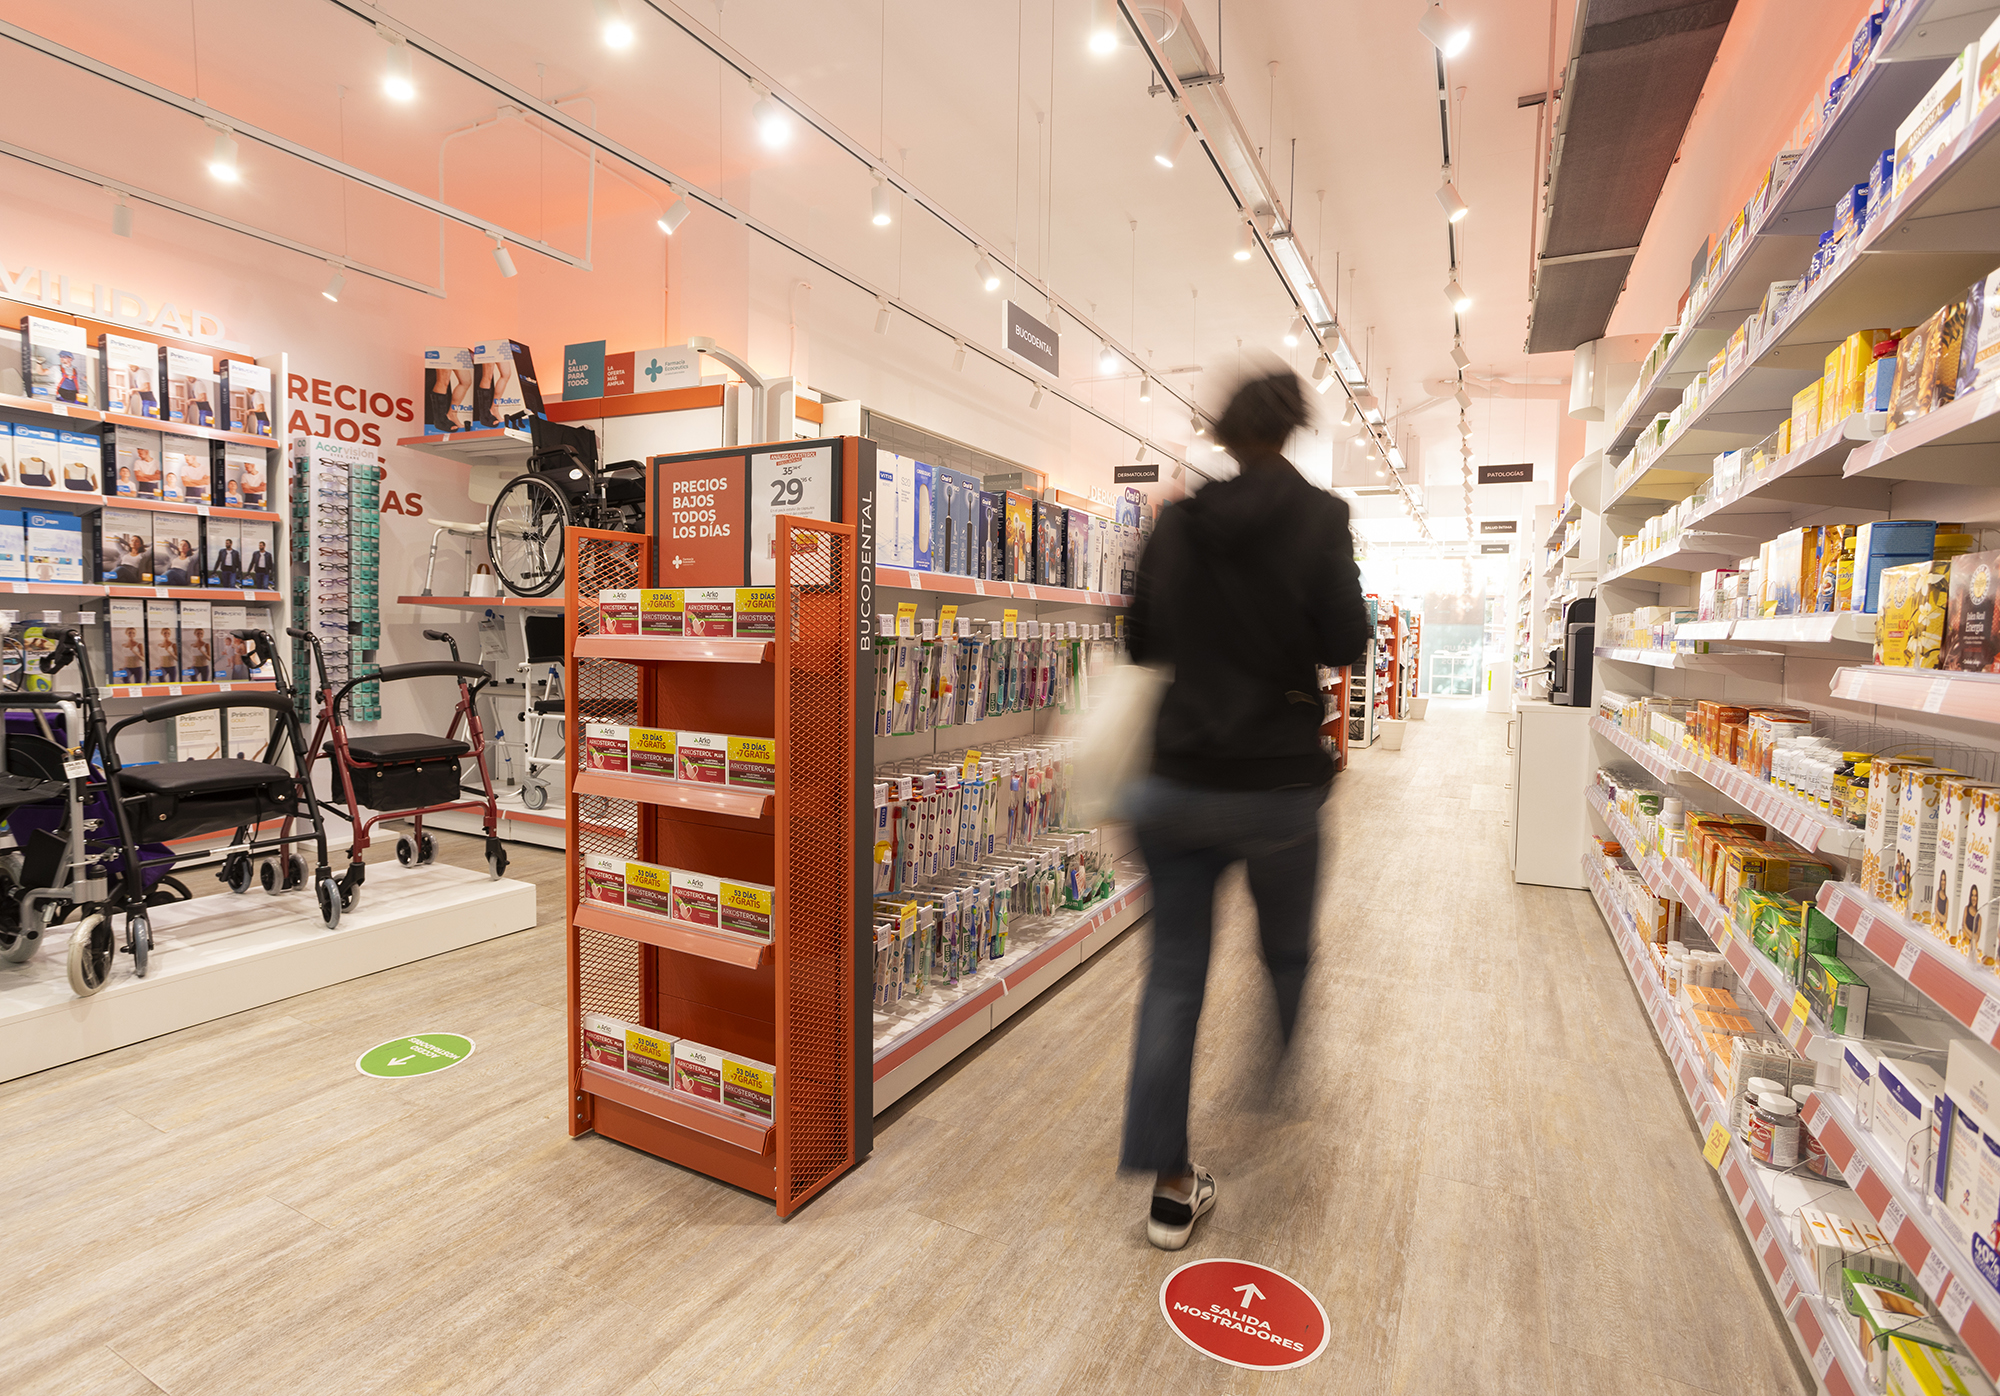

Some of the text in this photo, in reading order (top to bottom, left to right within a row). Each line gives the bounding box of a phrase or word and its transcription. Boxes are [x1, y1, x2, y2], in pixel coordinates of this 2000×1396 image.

[1015, 324, 1054, 357] BUCODENTAL
[568, 358, 577, 366] LA
[665, 359, 686, 367] Farmacia
[568, 364, 589, 373] SALUD
[567, 372, 585, 380] PARA
[567, 378, 589, 387] TODOS
[782, 466, 793, 476] 35
[880, 472, 893, 480] VITIS
[672, 477, 728, 494] PRECIOS
[770, 477, 803, 506] 29
[672, 494, 715, 509] BAJOS
[672, 509, 717, 524] TODOS
[672, 521, 731, 539] LOS DÍAS
[860, 490, 873, 651] BUCODENTAL
[660, 592, 672, 601] DÍAS
[759, 592, 775, 600] DÍAS
[738, 614, 775, 622] ARKOSTEROL
[650, 733, 663, 742] DÍAS
[643, 741, 666, 749] GRATIS
[751, 743, 766, 751] DÍAS
[632, 752, 662, 761] ARKOSTEROL
[744, 750, 770, 759] GRATIS
[730, 762, 766, 772] ARKOSTEROL
[1968, 833, 1990, 857] Jalea
[1972, 851, 1984, 863] neo
[1967, 858, 1987, 875] Woman
[645, 871, 658, 879] DÍAS
[639, 877, 661, 887] GRATIS
[628, 887, 657, 899] ARKOSTEROL
[742, 891, 757, 900] DÍAS
[736, 897, 760, 908] GRATIS
[723, 908, 757, 921] ARKOSTEROL
[645, 1039, 658, 1049] DÍAS
[639, 1045, 661, 1057] GRATIS
[628, 1053, 658, 1067] ARKOSTEROL
[744, 1069, 759, 1080] DÍAS
[737, 1075, 762, 1089] GRATIS
[725, 1084, 758, 1100] ARKOSTEROL
[1209, 1304, 1271, 1331] SALIDA
[1174, 1302, 1304, 1352] MOSTRADORES
